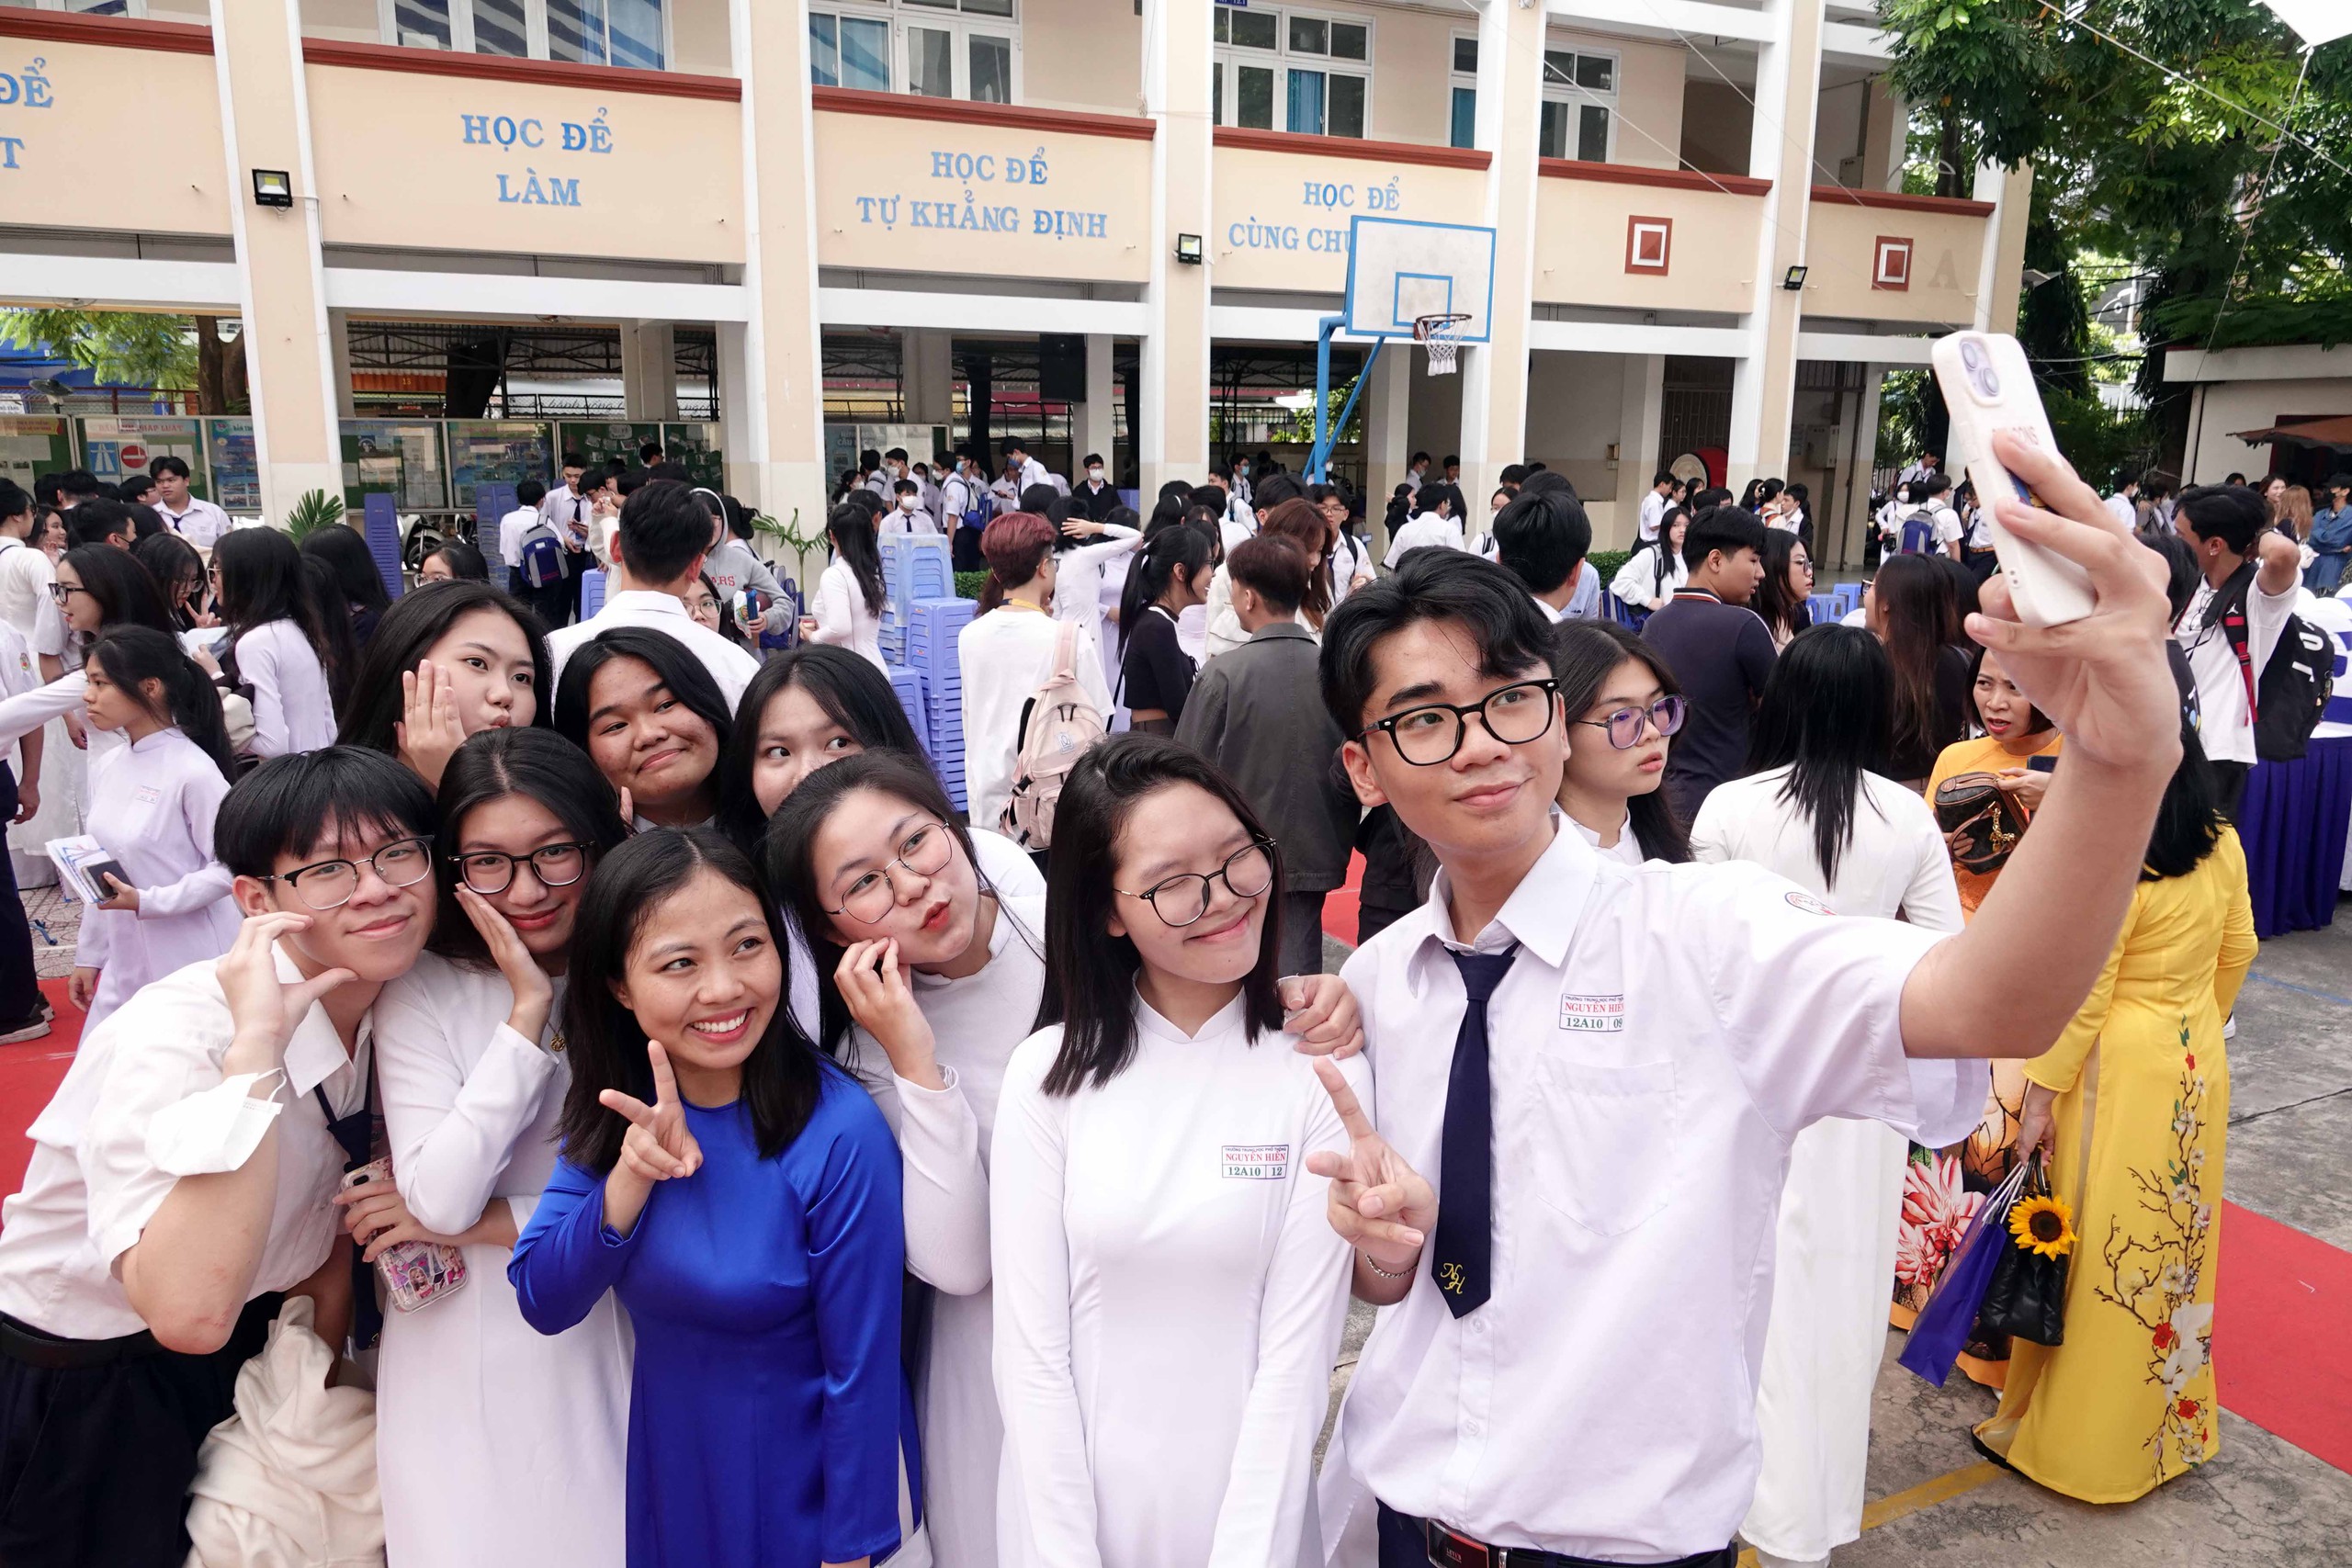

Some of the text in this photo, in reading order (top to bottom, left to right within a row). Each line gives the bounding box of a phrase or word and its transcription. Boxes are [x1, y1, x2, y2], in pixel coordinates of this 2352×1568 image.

[460, 107, 614, 153] HỌC ĐỂ
[931, 146, 1048, 185] HỌC ĐỂ
[496, 167, 582, 206] LÀM
[1303, 175, 1400, 212] HỌC ĐỂ
[855, 194, 900, 231] TỰ
[1033, 209, 1108, 241] ĐỊNH
[1228, 216, 1299, 250] CÙNG
[1566, 1017, 1603, 1029] 12A10
[1228, 1167, 1283, 1176] 12A10 12
